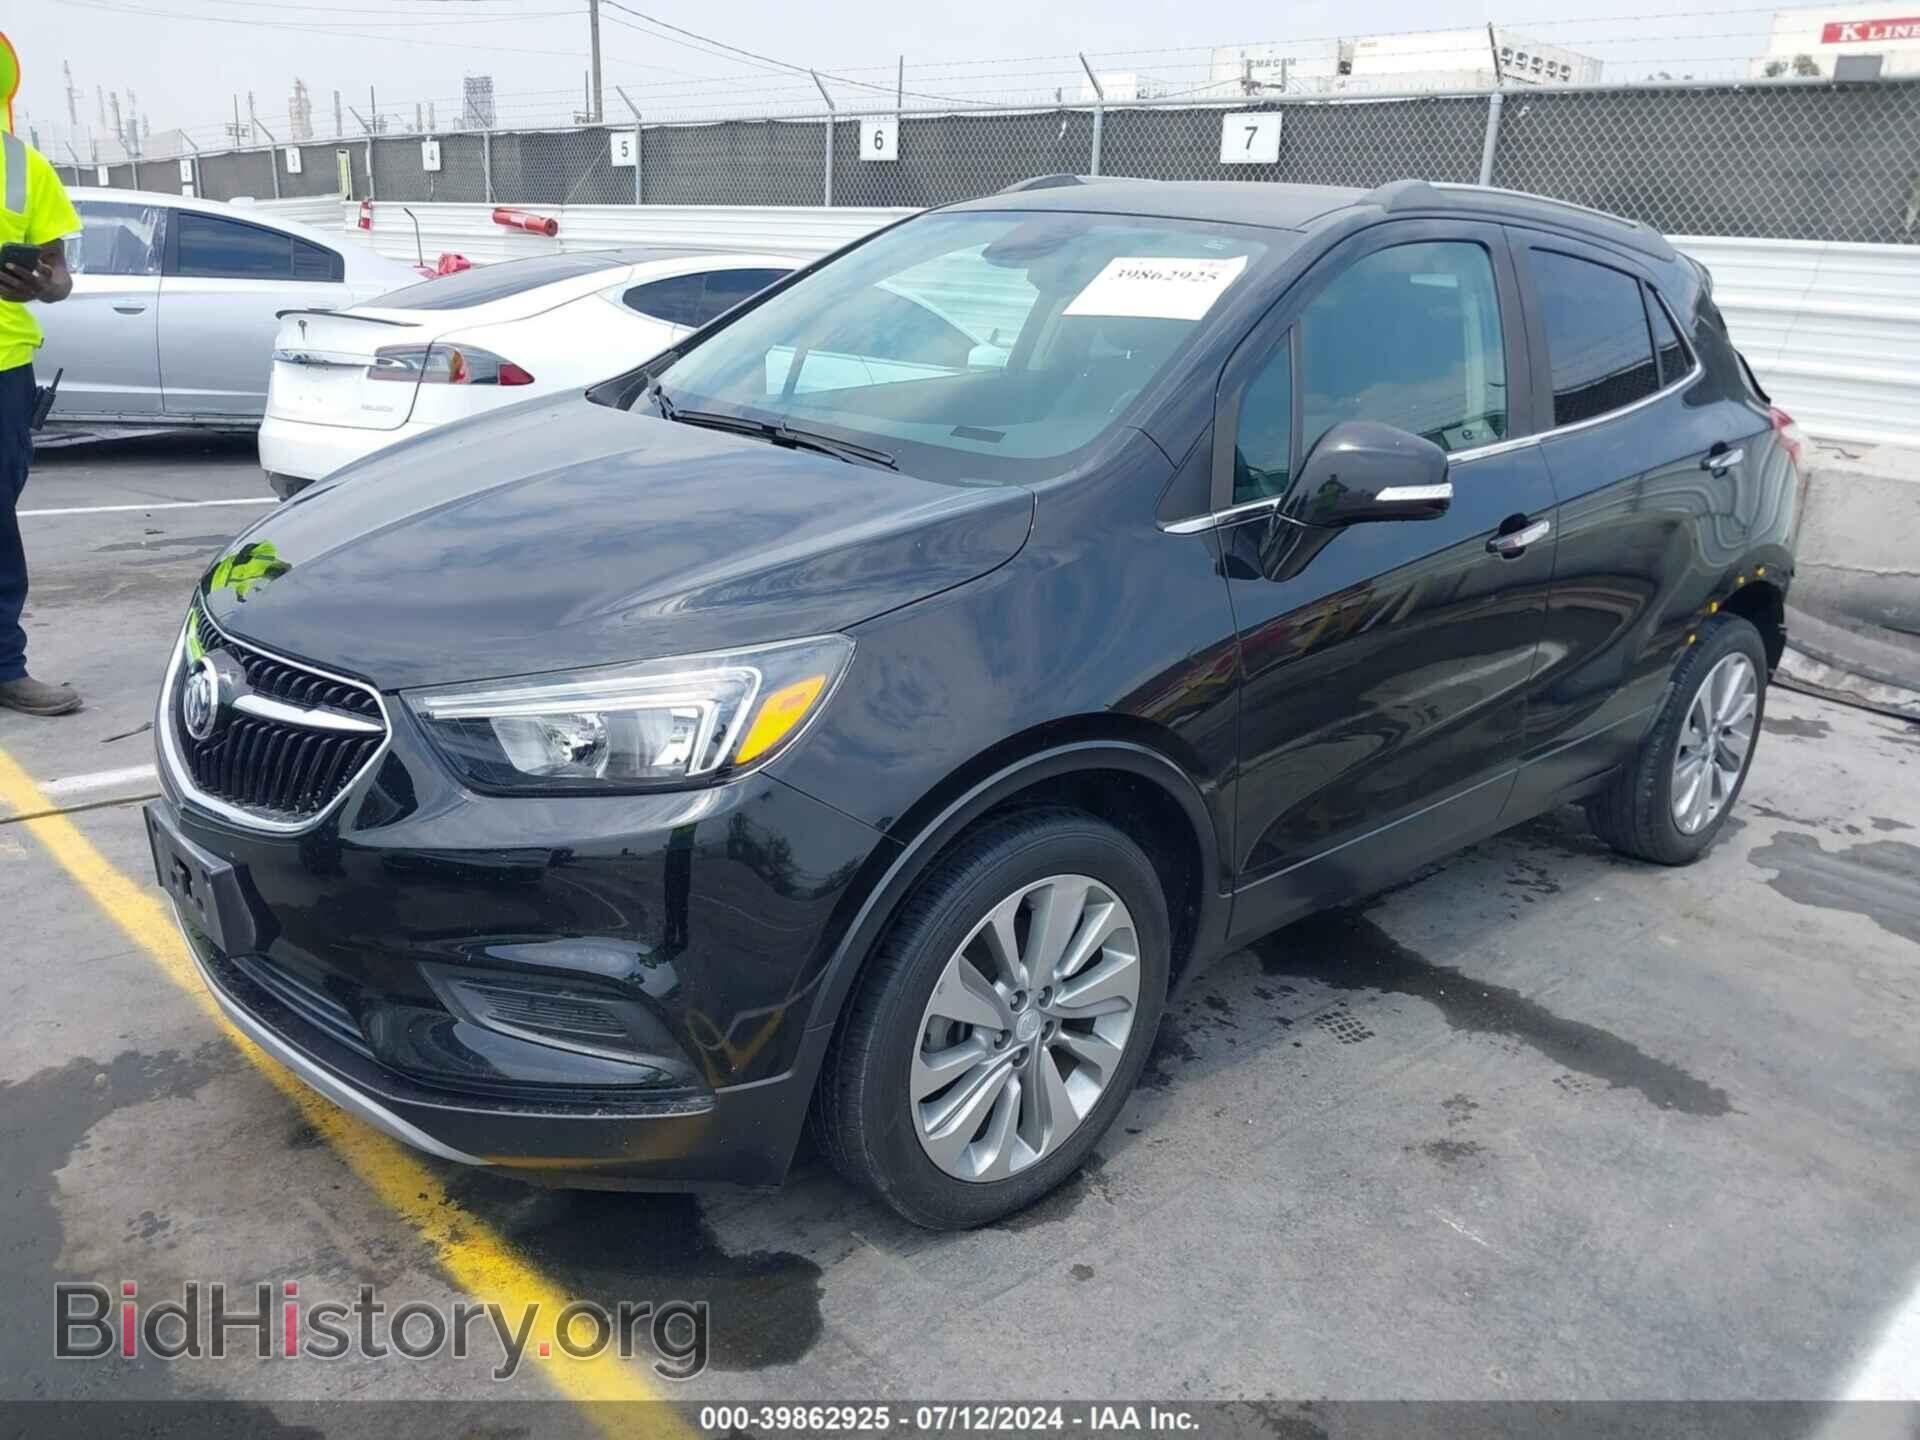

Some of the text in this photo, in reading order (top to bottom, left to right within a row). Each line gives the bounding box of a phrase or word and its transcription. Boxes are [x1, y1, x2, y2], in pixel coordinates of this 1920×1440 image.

[1839, 23, 1862, 42] K
[874, 129, 884, 151] 6
[1244, 125, 1258, 150] 7
[621, 140, 629, 158] 5
